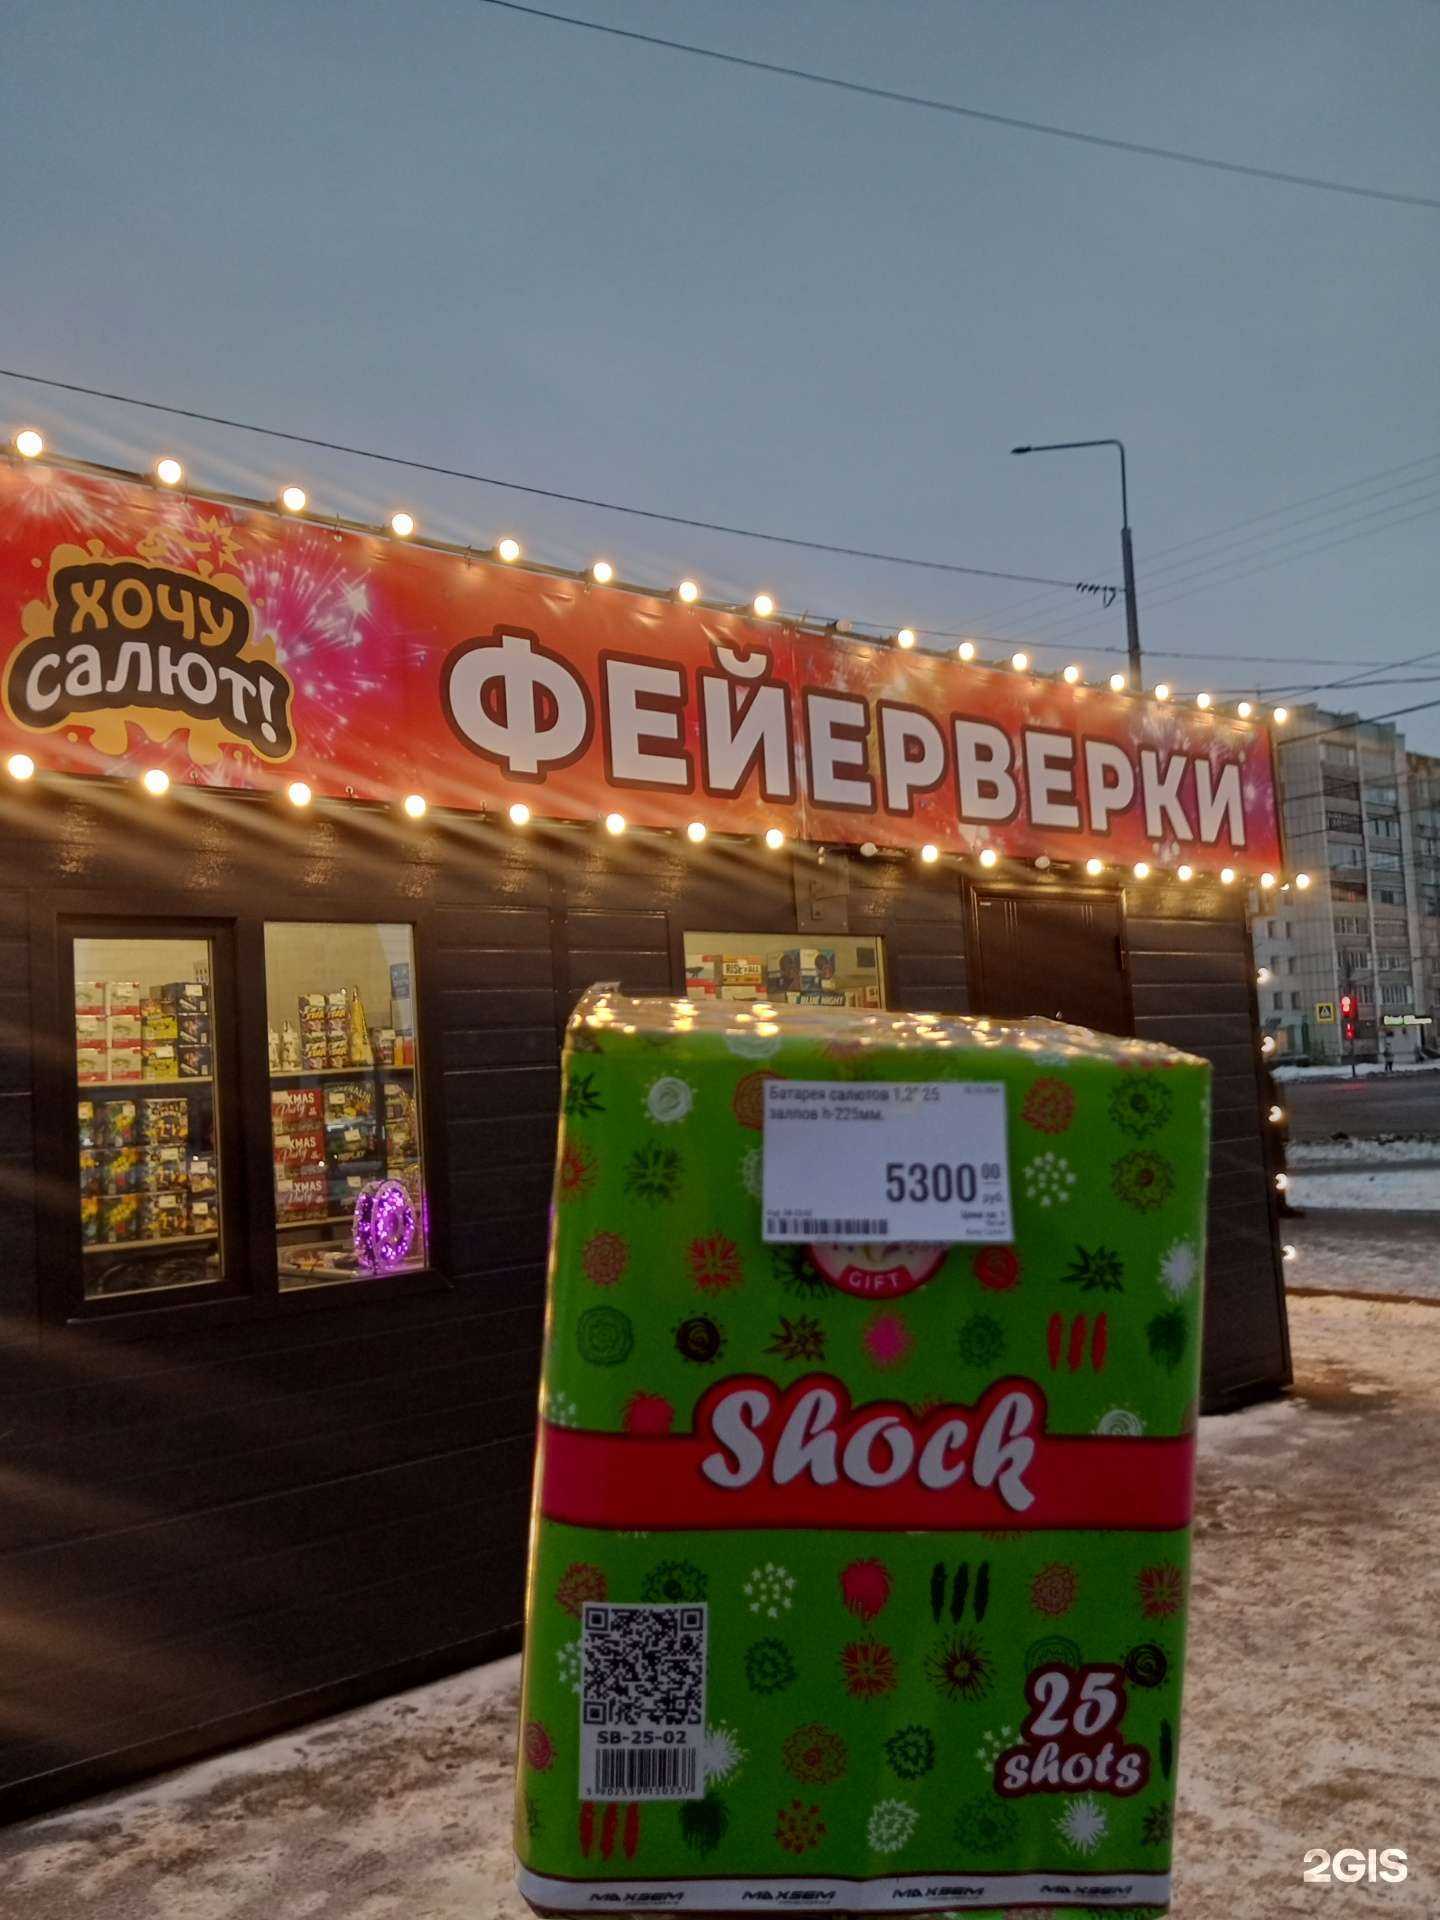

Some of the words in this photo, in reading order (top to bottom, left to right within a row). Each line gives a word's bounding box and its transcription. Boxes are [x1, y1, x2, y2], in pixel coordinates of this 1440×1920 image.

[448, 634, 1247, 848] ФЕЙЕРВЕРКИ
[287, 1091, 315, 1105] XMAS
[769, 1086, 826, 1103] Батарея
[829, 1088, 890, 1101] салютов
[922, 1086, 940, 1101] 25
[290, 1136, 317, 1150] XMAS
[294, 1180, 323, 1193] XMAS
[885, 1162, 977, 1203] 5300
[848, 1271, 901, 1291] GIFT
[702, 1387, 1036, 1513] Shock
[1031, 1670, 1119, 1737] 25
[597, 1730, 687, 1744] SB-25-02
[1002, 1741, 1141, 1790] shots
